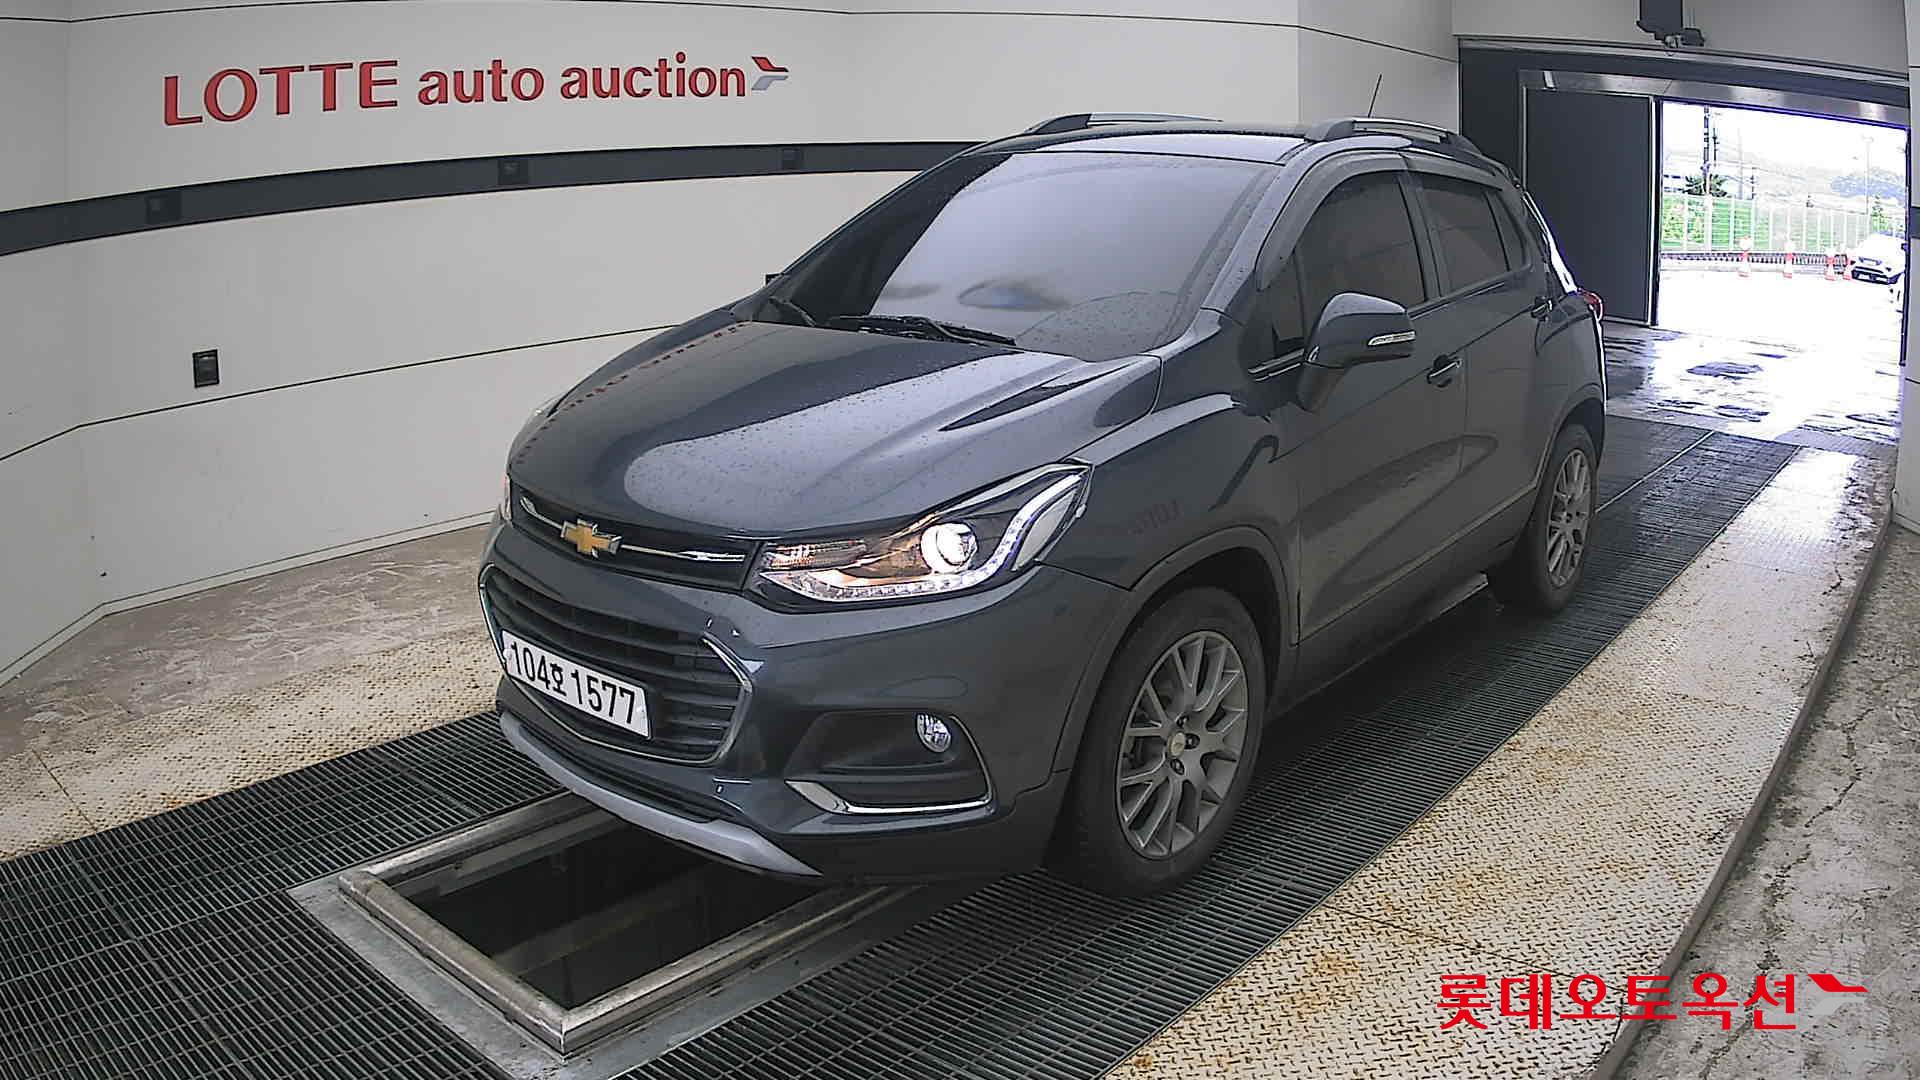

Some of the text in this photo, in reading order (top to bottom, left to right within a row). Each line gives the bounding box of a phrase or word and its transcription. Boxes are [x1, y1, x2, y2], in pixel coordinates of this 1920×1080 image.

[164, 51, 746, 126] LOTTE auto auction
